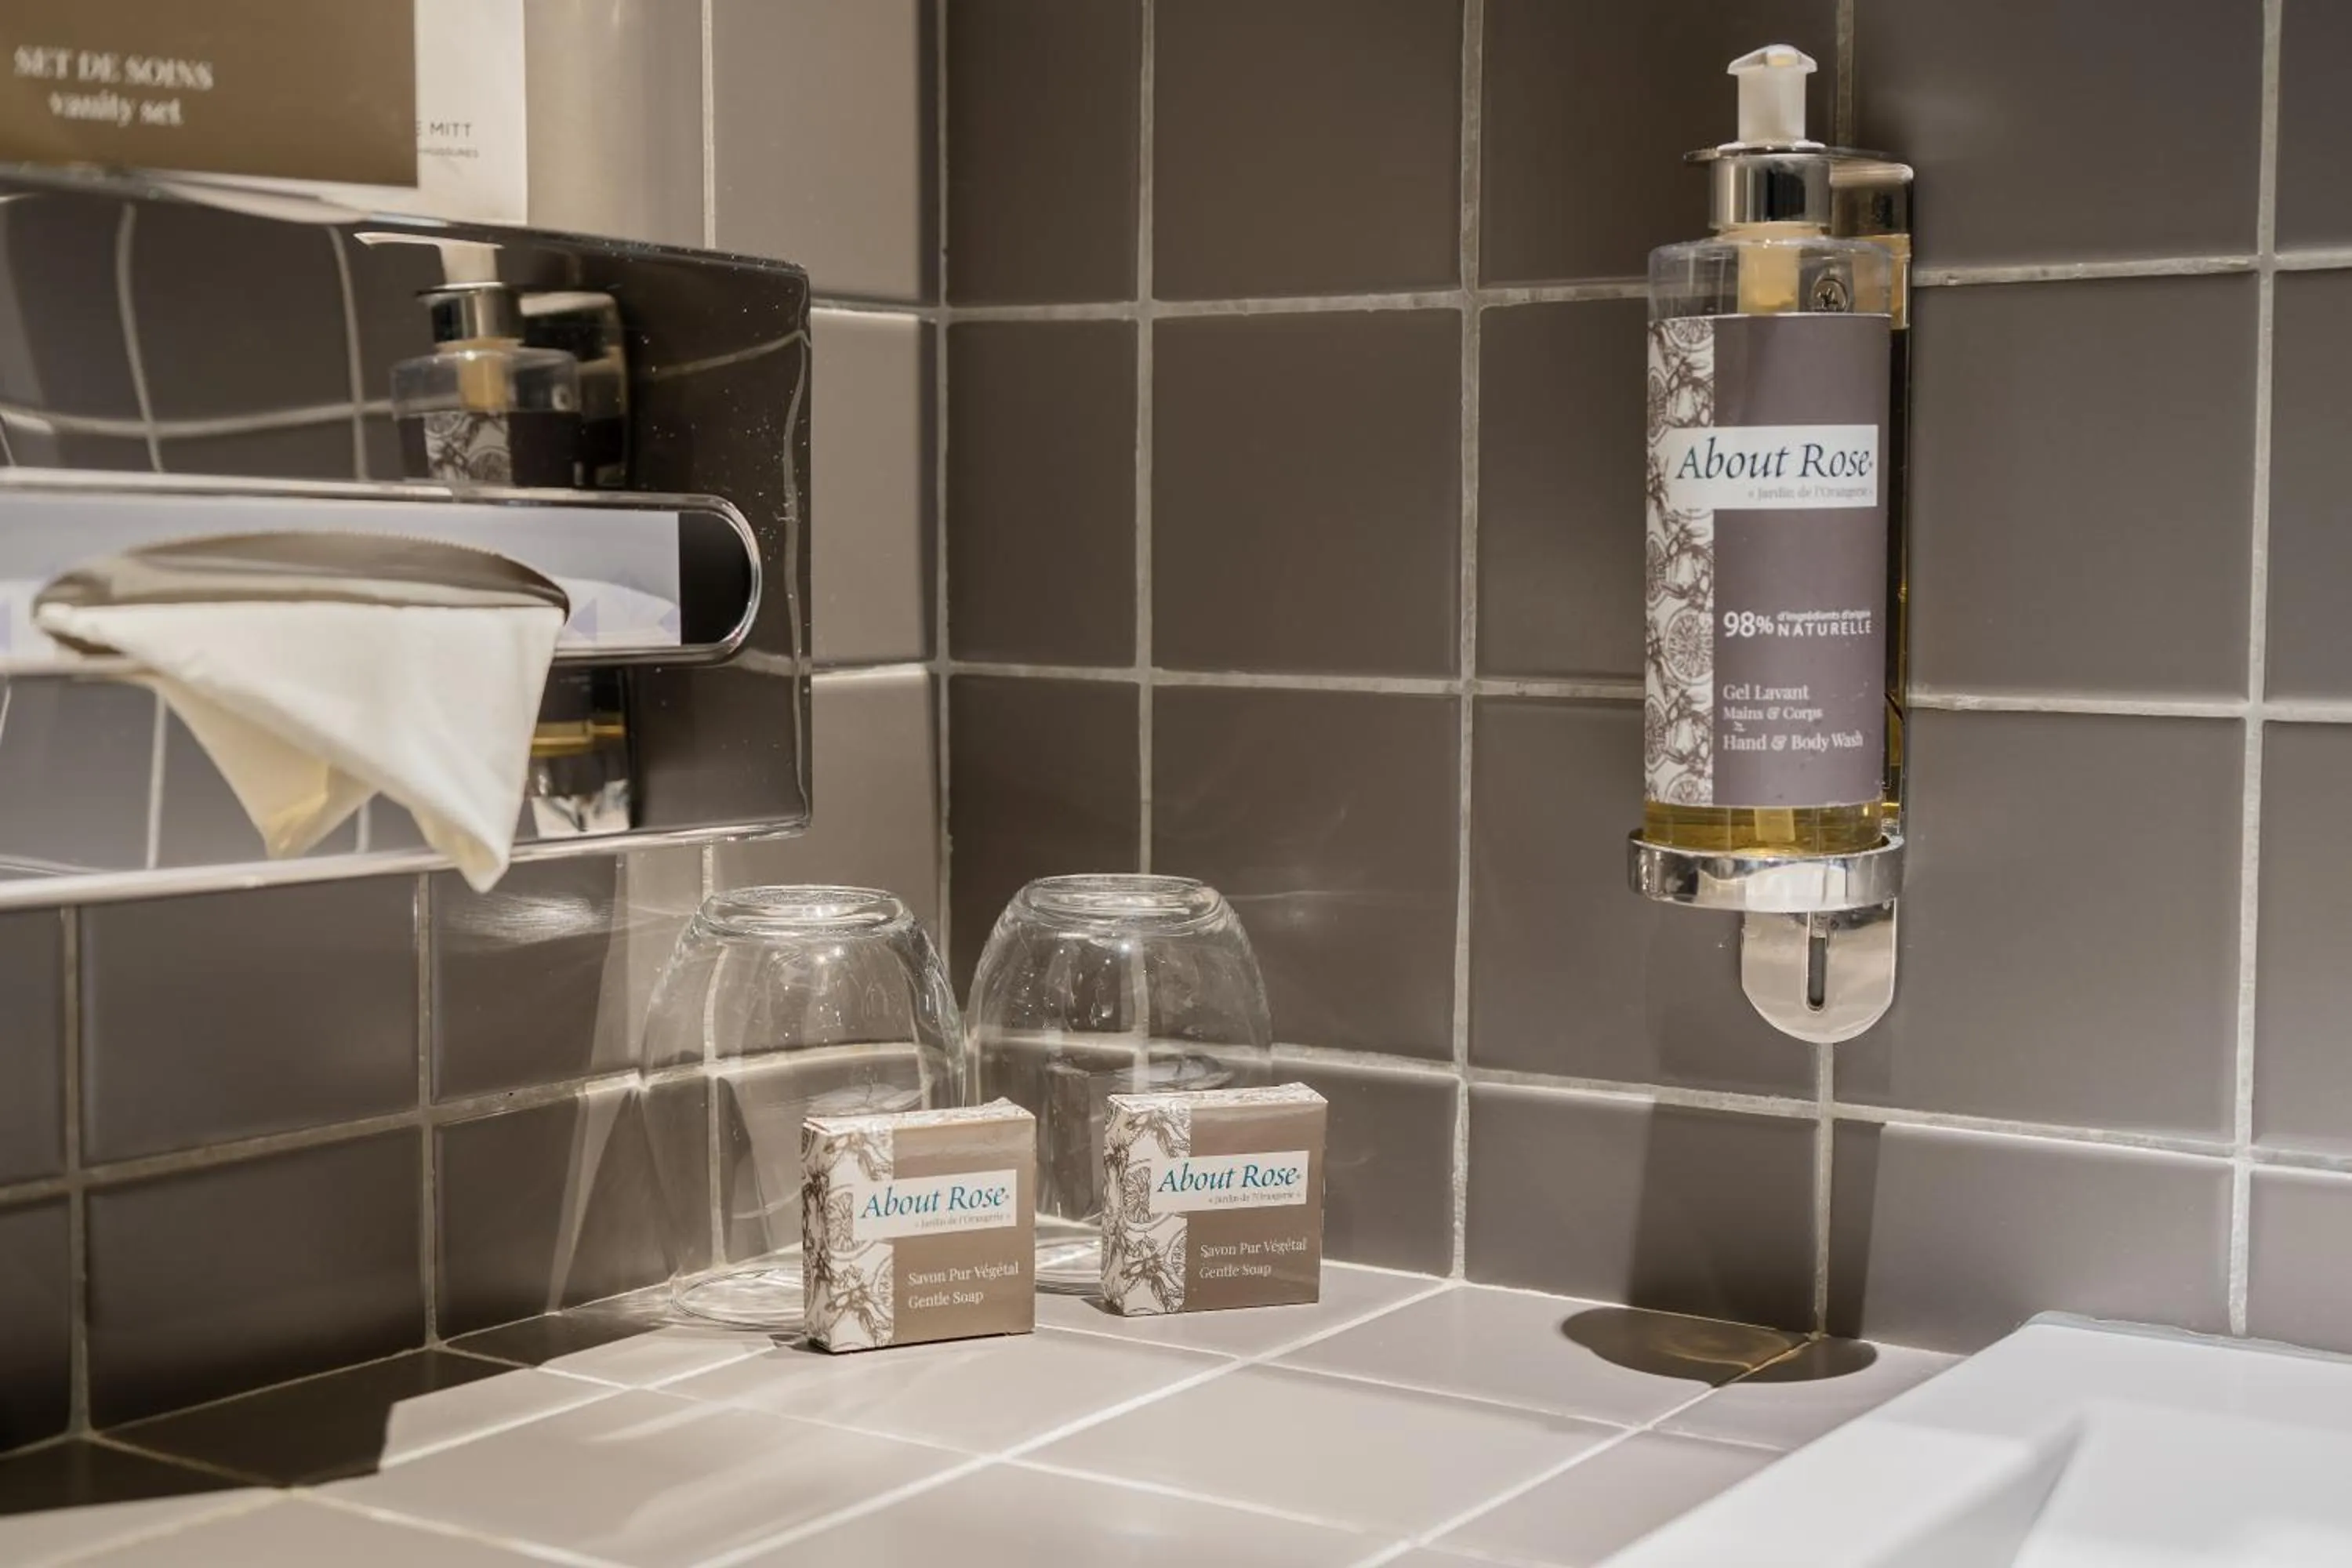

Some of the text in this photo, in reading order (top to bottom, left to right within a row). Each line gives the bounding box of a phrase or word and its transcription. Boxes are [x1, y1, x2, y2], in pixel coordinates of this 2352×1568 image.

[14, 45, 213, 91] SET DE SOINS
[48, 89, 184, 128] vanity set
[430, 122, 472, 138] MITT
[1675, 437, 1790, 479] About
[1722, 611, 1775, 638] 98%
[1777, 620, 1872, 637] NATURELLE
[1722, 684, 1810, 701] Gel Lavant
[1722, 706, 1824, 722] Mains & Corps
[1722, 729, 1864, 753] Hand & Body Wash
[1156, 1162, 1235, 1192] About
[861, 1185, 941, 1218] About
[1200, 1236, 1308, 1258] Savon Pur Végétal
[908, 1261, 1019, 1285] Savon Pur Végétal
[1199, 1263, 1272, 1279] Gentle Soap
[908, 1290, 985, 1308] Gentle Soap
